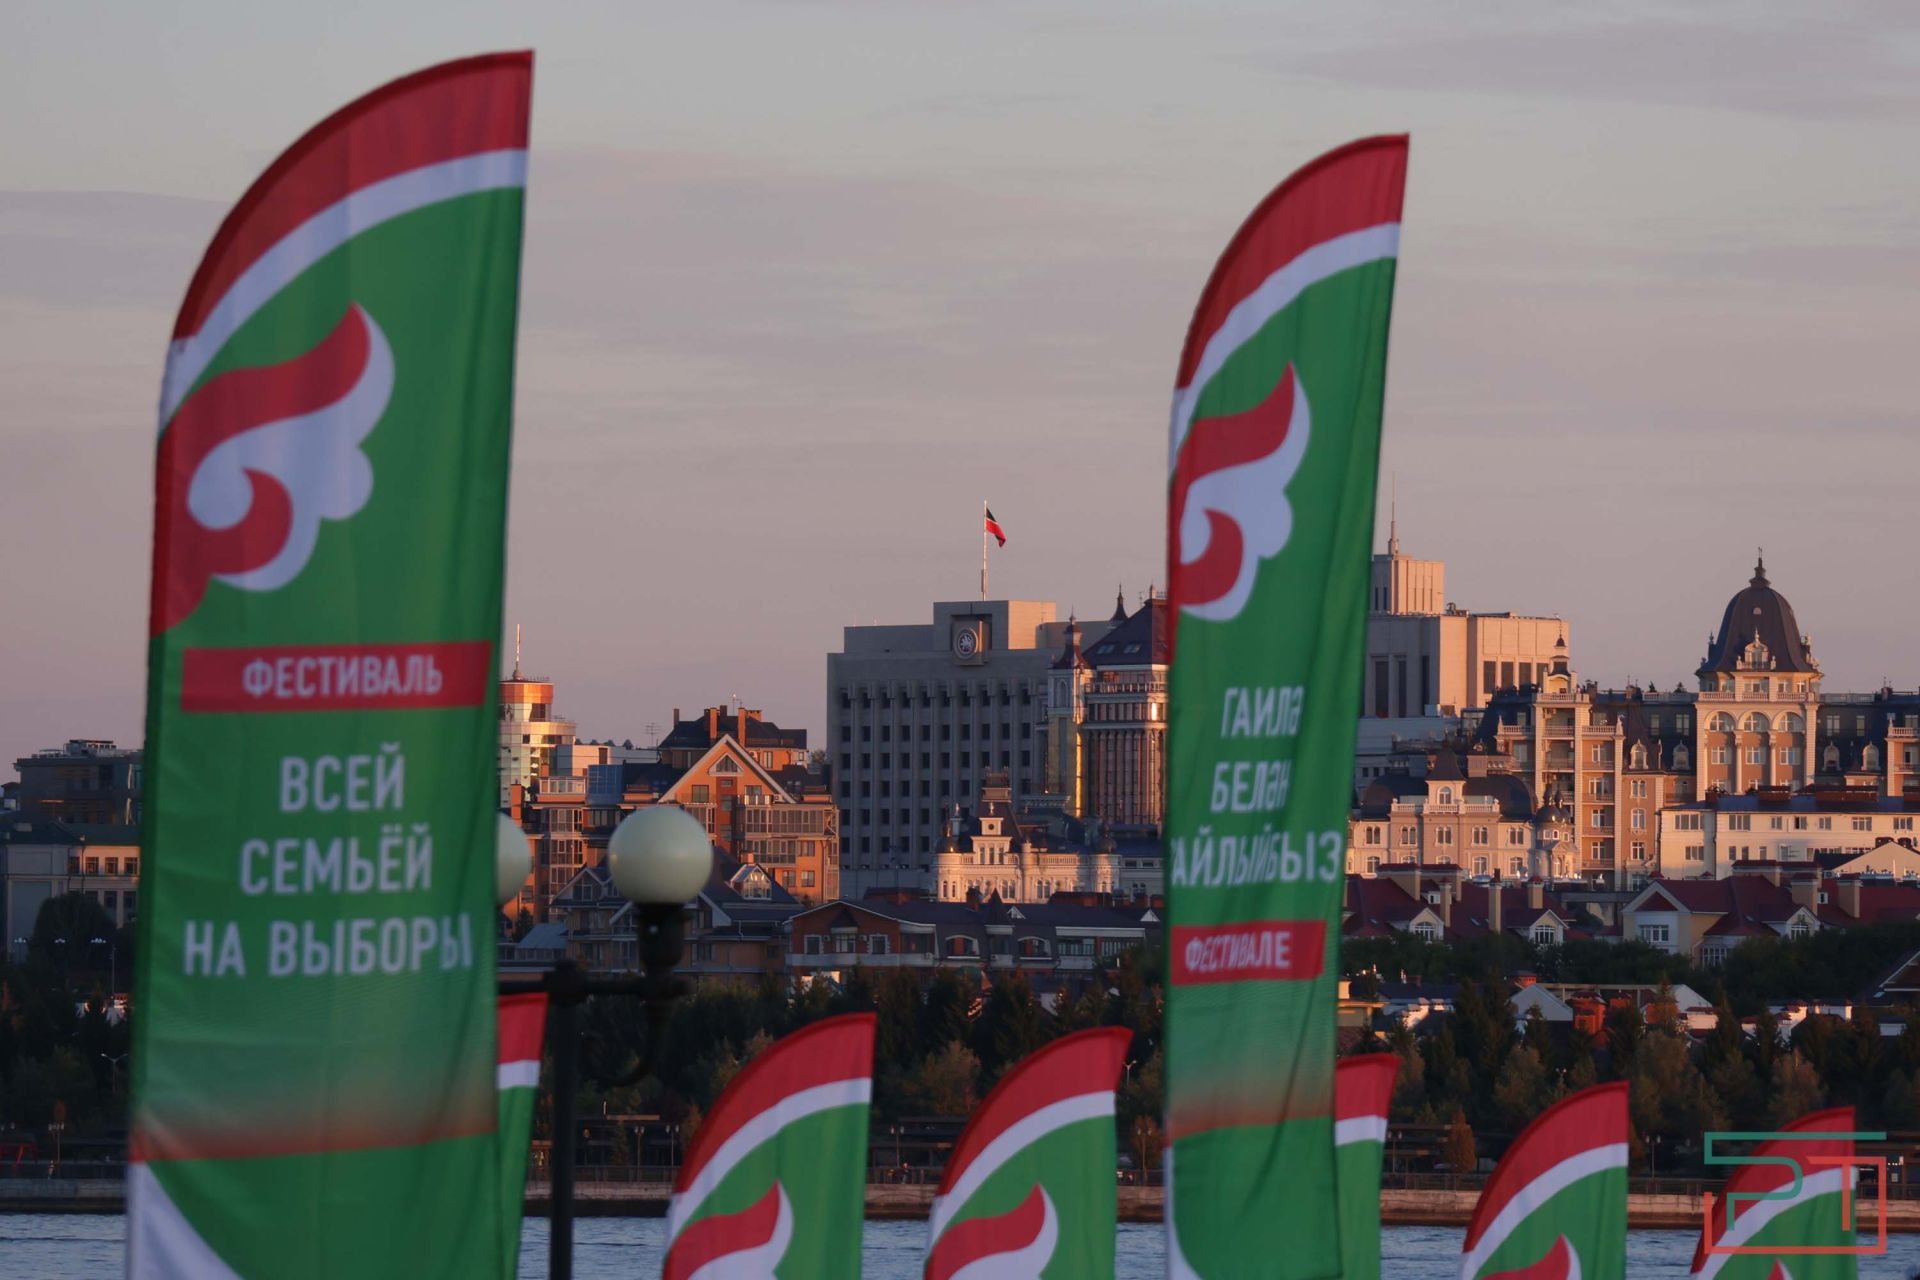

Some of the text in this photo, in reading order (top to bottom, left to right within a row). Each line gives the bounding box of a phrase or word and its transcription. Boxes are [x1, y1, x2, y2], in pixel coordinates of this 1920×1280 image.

[242, 654, 443, 698] ФЕСТИВАЛЬ
[279, 740, 405, 812] ВСЕЙ
[239, 823, 433, 895] СЕМЬЁЙ
[1170, 822, 1342, 888] АЙЛЫЙБЫЗ
[183, 911, 473, 977] НА ВЫБОРЫ
[1184, 930, 1292, 973] ФЕСТИВАЛЕ
